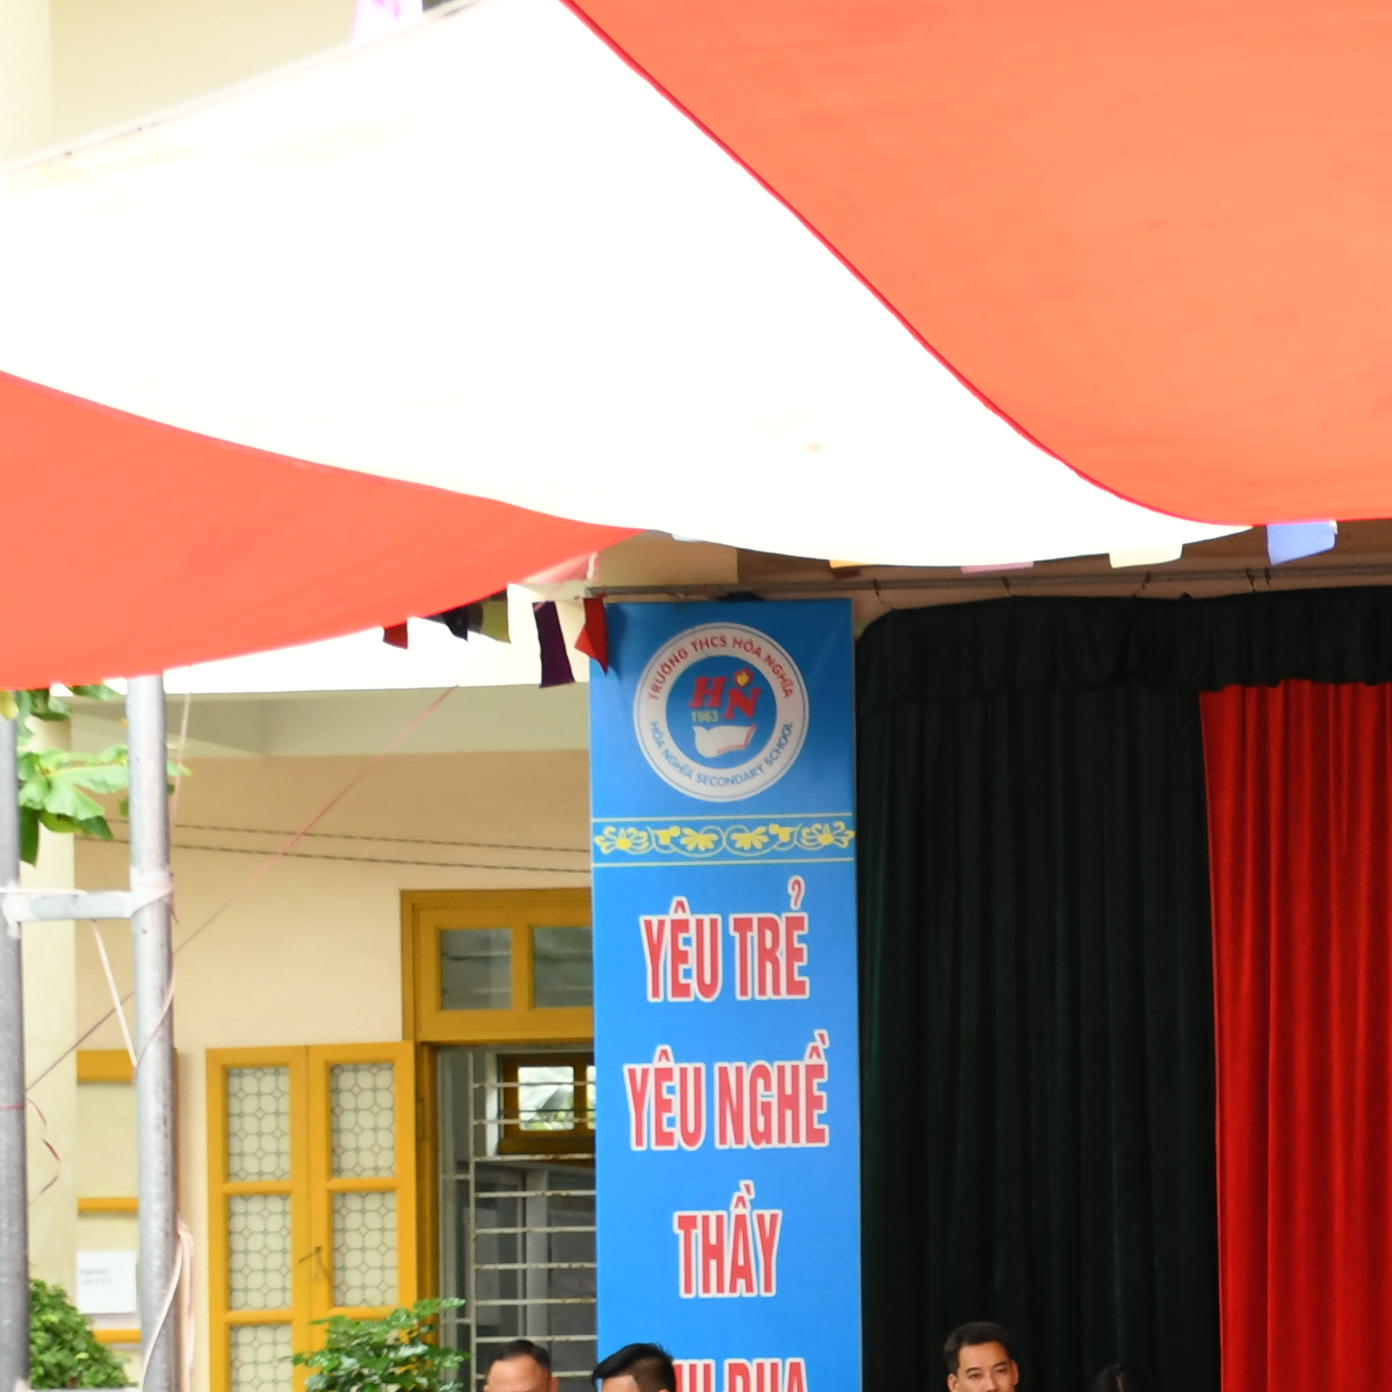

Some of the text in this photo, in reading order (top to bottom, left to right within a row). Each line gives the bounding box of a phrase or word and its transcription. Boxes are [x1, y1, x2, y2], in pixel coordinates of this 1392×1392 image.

[691, 636, 727, 652] THCS
[695, 763, 765, 787] SECONDARY
[640, 875, 811, 1002] YÊU TRẺ
[624, 1030, 830, 1151] YÊU NGHỀ
[674, 1180, 784, 1299] THẦY
